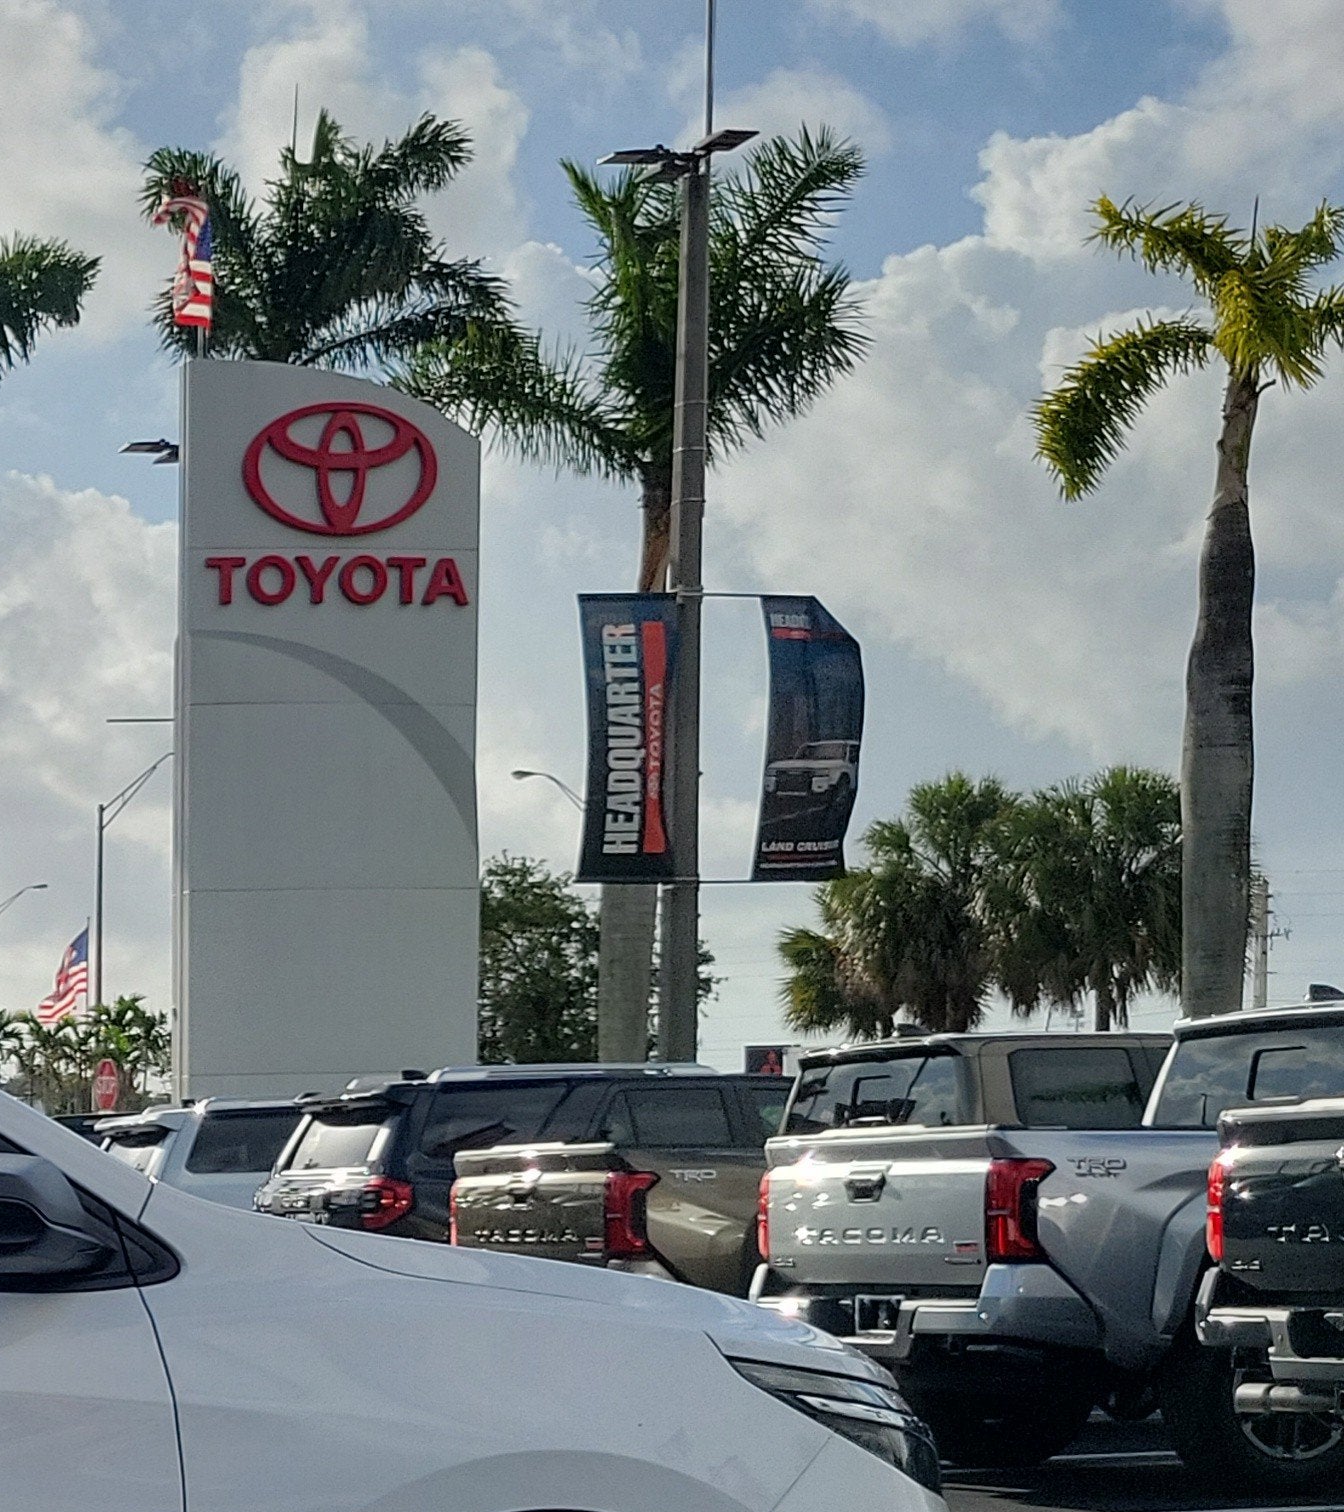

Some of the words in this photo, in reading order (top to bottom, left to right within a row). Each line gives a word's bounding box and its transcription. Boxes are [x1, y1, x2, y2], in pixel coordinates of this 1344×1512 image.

[206, 555, 468, 607] TOYOTA
[602, 623, 646, 854] HEADQUARTER
[649, 684, 662, 769] TOYOTA
[761, 842, 794, 852] LAND
[794, 1226, 945, 1246] TACOMA
